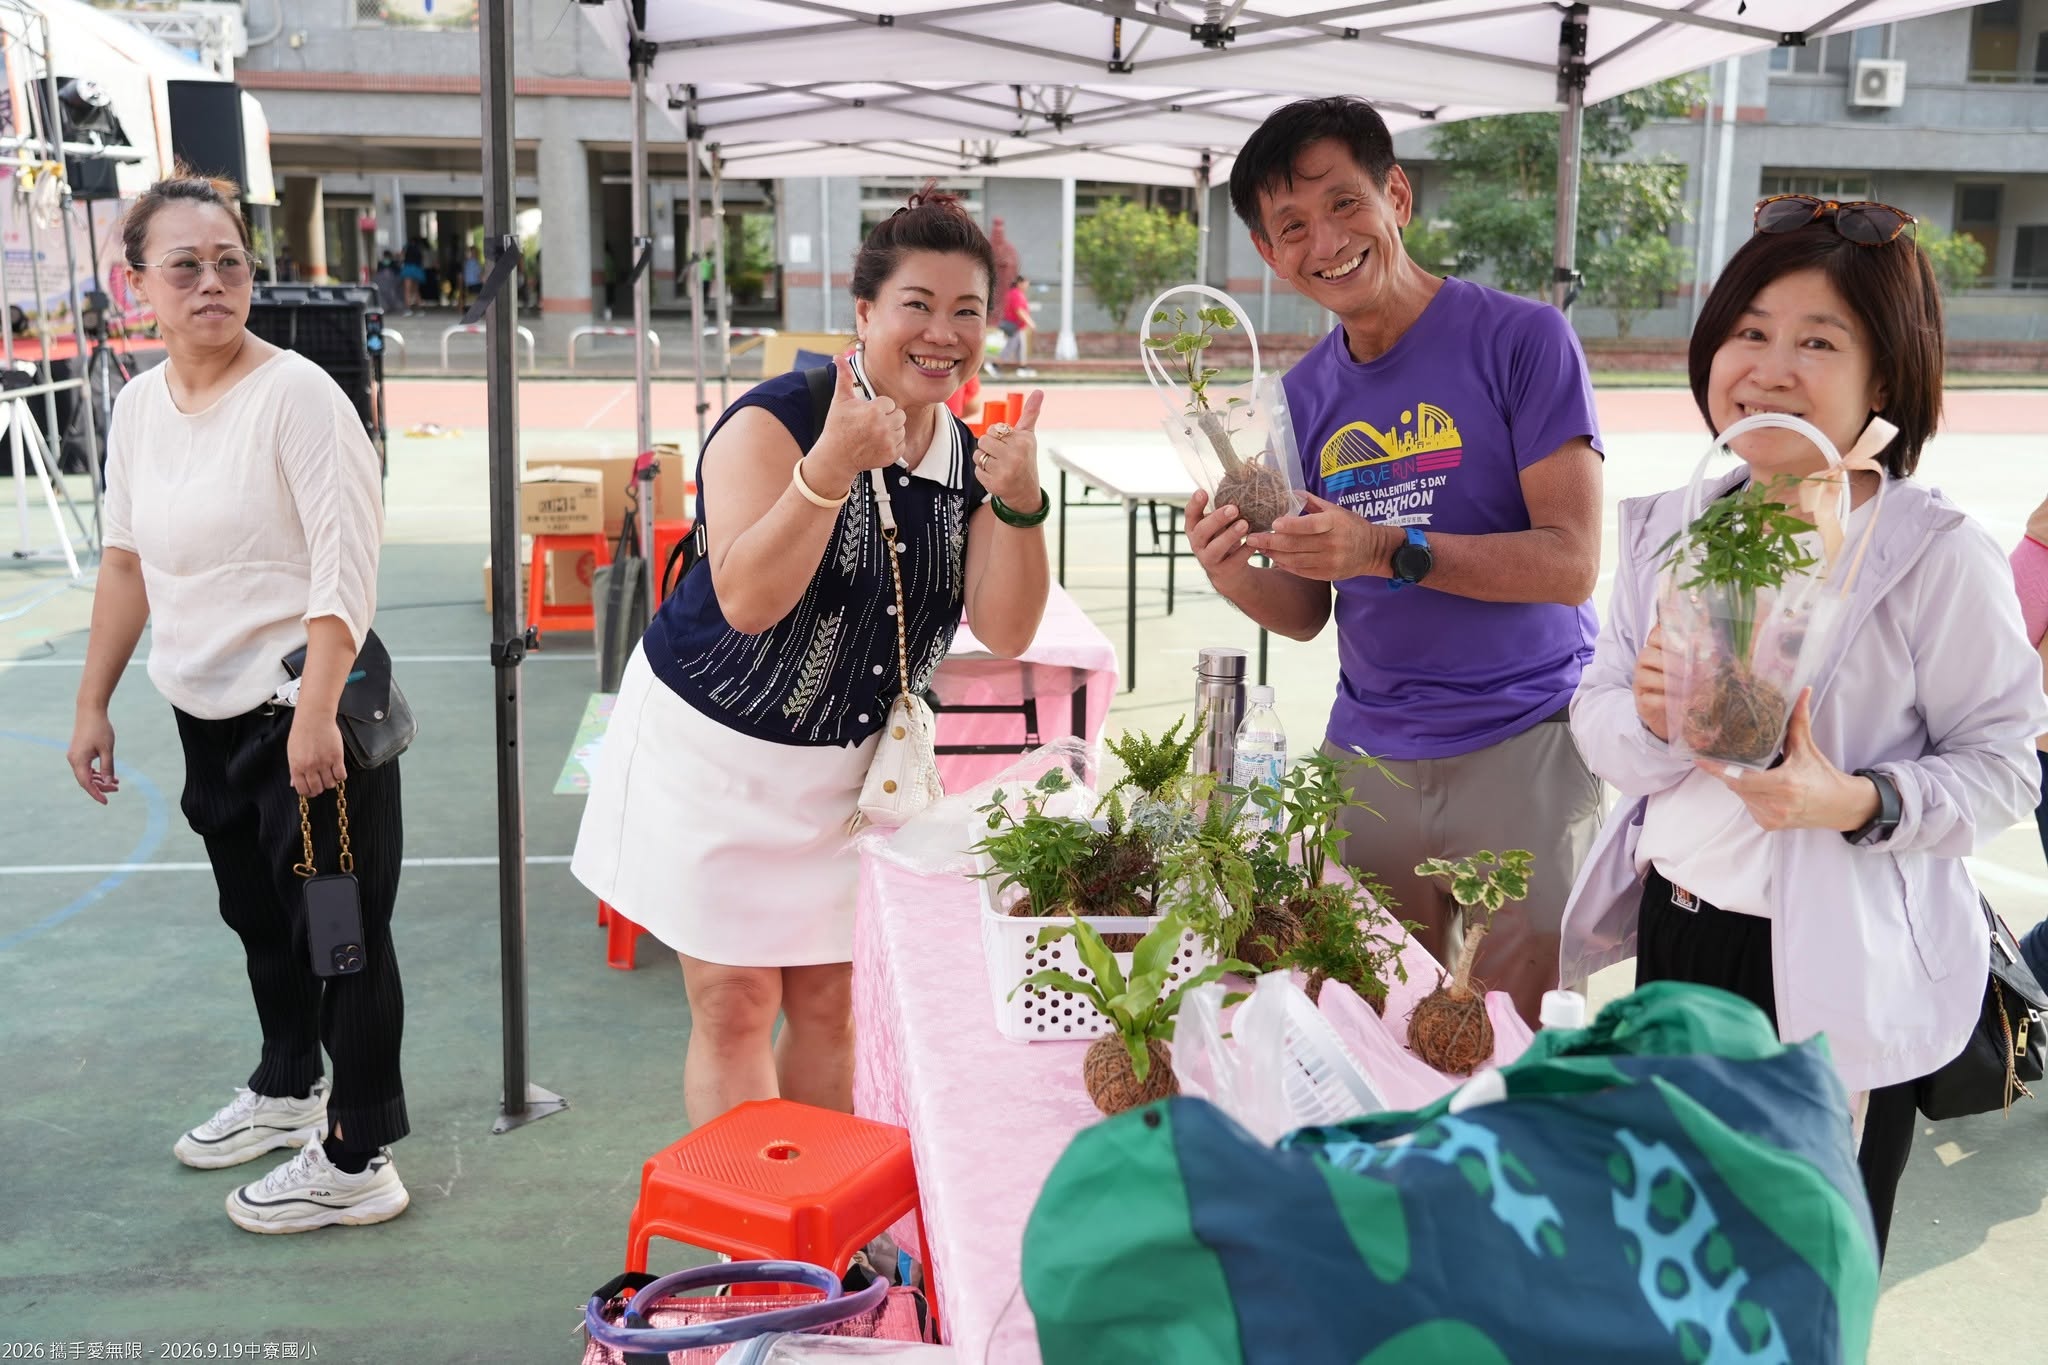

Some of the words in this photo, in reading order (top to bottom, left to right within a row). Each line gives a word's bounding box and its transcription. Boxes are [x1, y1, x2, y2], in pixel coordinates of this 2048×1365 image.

[1356, 464, 1390, 487] LOVE
[1392, 460, 1416, 480] RUN
[1337, 490, 1371, 506] HINESE
[1428, 475, 1447, 487] DAY
[1352, 489, 1434, 518] MARATHON
